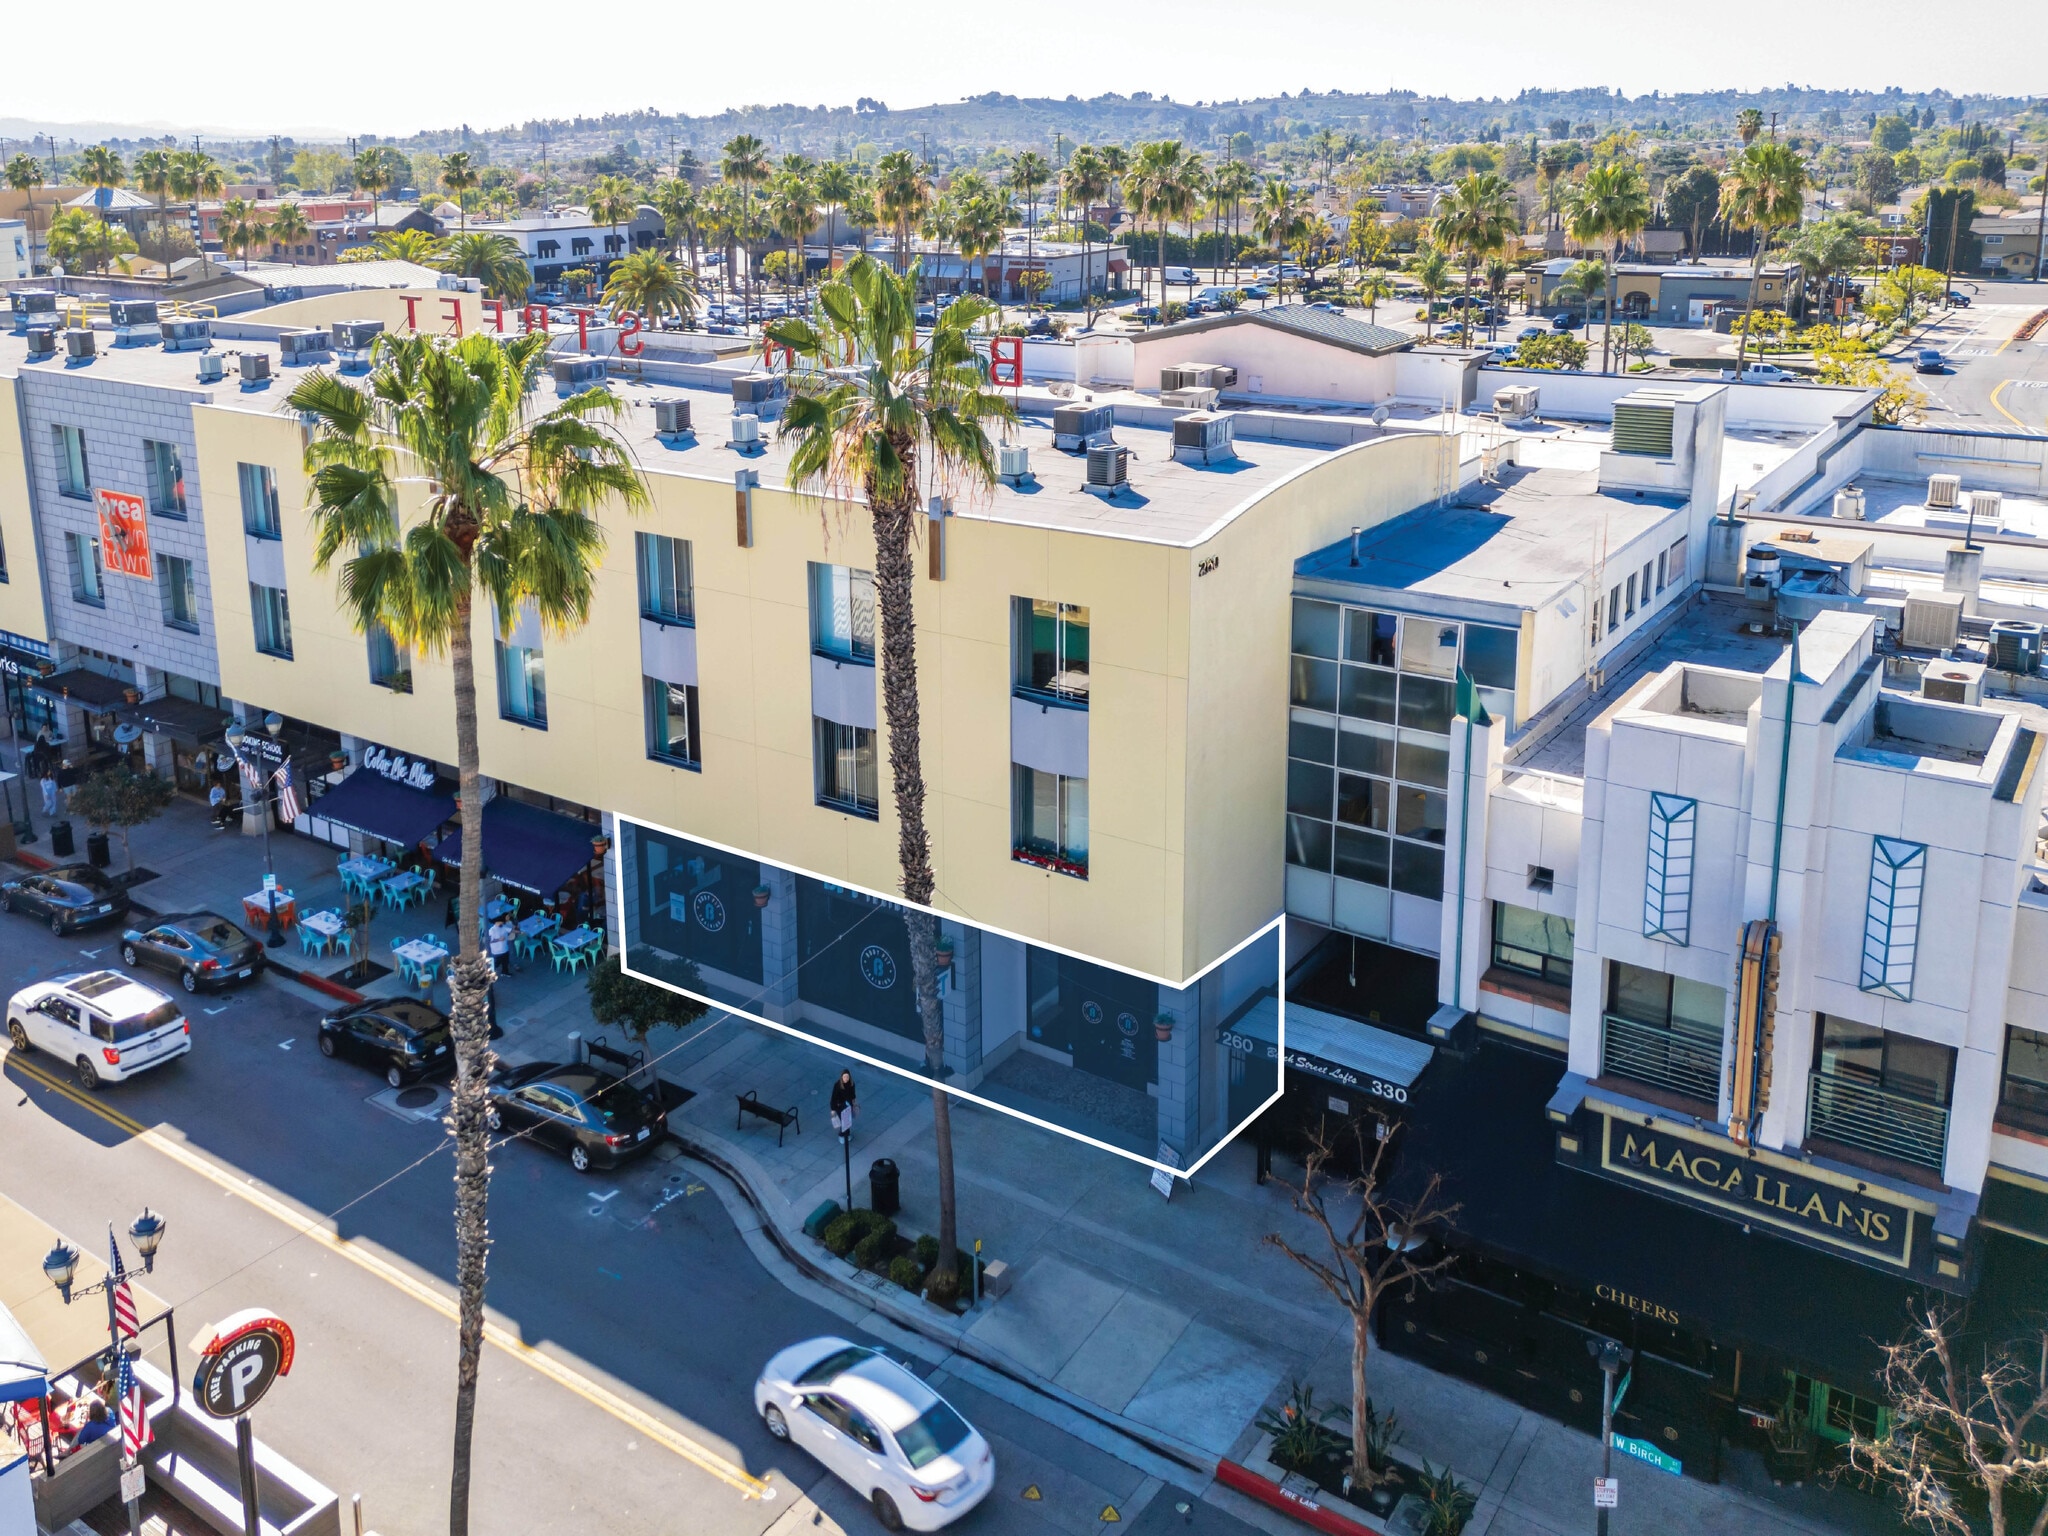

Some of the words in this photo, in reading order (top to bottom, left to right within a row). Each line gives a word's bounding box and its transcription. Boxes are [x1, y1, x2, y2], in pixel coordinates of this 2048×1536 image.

[98, 491, 143, 522] brea
[0, 656, 18, 674] rks
[261, 740, 283, 755] SCHOOL
[364, 745, 393, 772] Color
[391, 756, 409, 780] Me
[1222, 1031, 1254, 1053] 260
[1266, 1046, 1295, 1064] Bch
[1295, 1056, 1328, 1075] Street
[1328, 1068, 1358, 1085] Lofts
[1371, 1080, 1408, 1103] 330
[1620, 1133, 1891, 1241] MACALLANS
[1595, 1284, 1680, 1326] CHEERS
[210, 1375, 222, 1404] FREE
[216, 1339, 262, 1374] PARKING
[231, 1354, 263, 1409] P
[1629, 1442, 1662, 1466] BIRCH
[1280, 1488, 1298, 1501] FIRE
[1299, 1497, 1320, 1511] LANE
